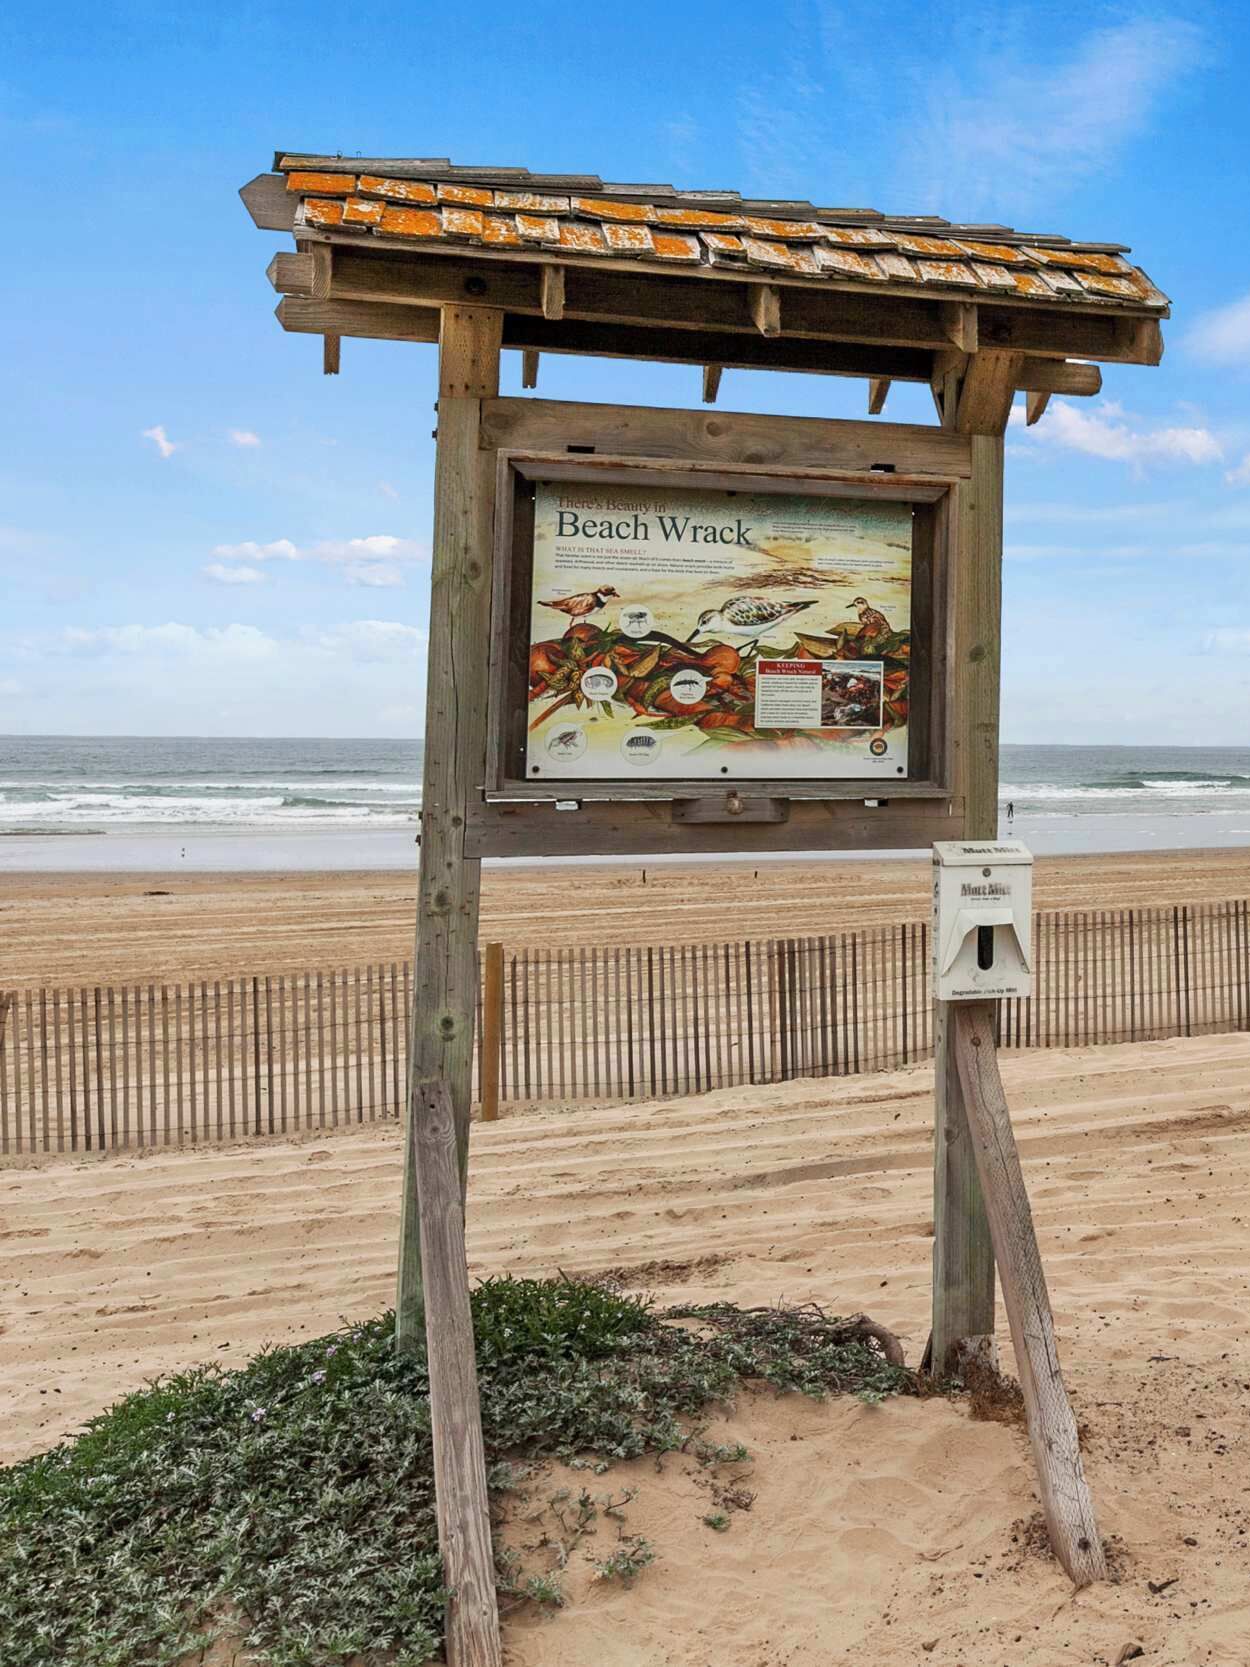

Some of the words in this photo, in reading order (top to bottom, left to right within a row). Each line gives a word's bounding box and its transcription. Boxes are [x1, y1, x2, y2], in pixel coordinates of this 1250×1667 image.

[558, 496, 602, 511] There's
[606, 500, 650, 515] Beauty
[654, 502, 666, 513] in
[555, 510, 650, 541] Beach
[656, 515, 753, 546] Wrack
